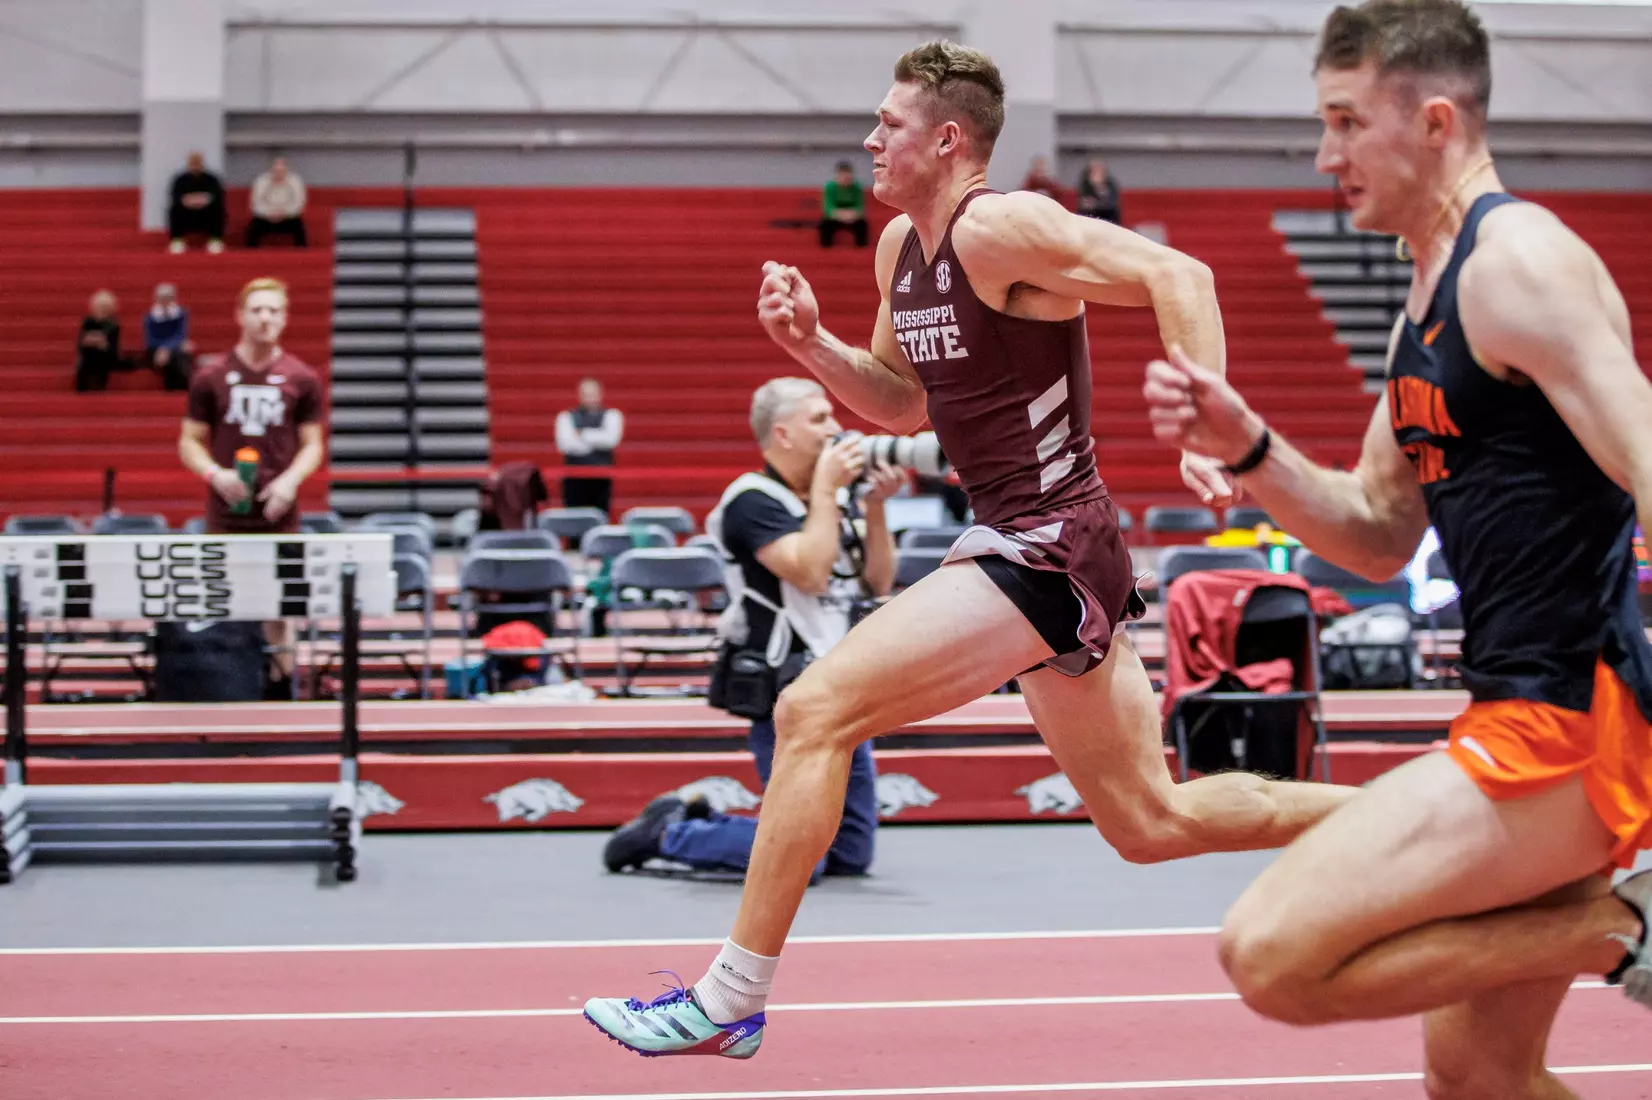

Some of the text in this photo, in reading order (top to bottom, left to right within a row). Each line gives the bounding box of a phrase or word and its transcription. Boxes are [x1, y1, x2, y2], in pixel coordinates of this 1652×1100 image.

[937, 262, 951, 291] SEC
[893, 304, 957, 330] MISSISSIPPI
[136, 543, 226, 560] UCS
[136, 563, 226, 580] UCS
[141, 582, 231, 599] UCS
[141, 601, 230, 618] UCS
[719, 1026, 747, 1051] ADIZERO
